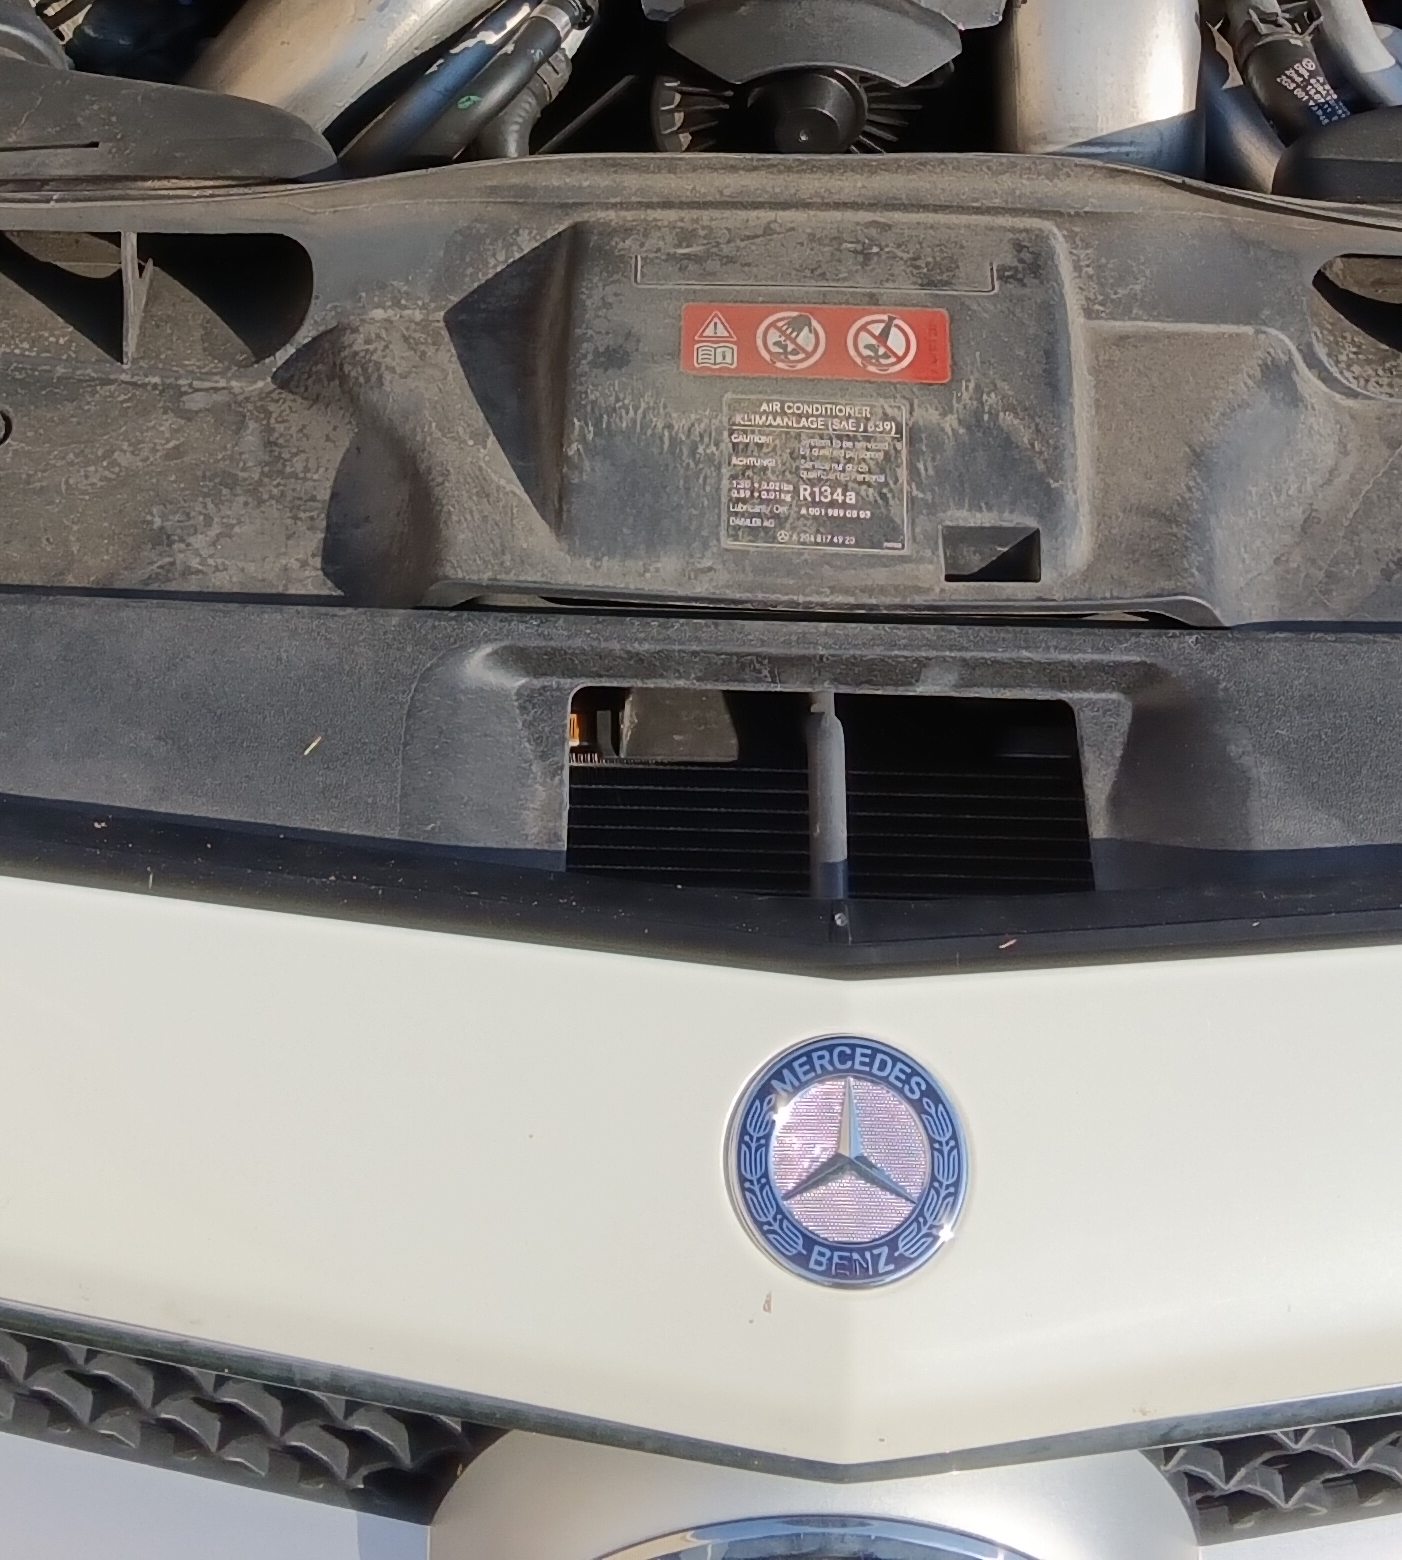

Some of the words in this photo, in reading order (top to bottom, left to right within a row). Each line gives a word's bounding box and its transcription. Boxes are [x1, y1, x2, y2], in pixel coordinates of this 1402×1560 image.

[760, 401, 781, 413] AIR
[784, 403, 870, 418] CONDITIONER
[735, 413, 825, 429] KLIMAANLAGE
[828, 419, 857, 433] (SAE
[799, 485, 856, 504] R134a
[771, 1045, 927, 1101] MERCEDES
[808, 1245, 895, 1277] BENZ
